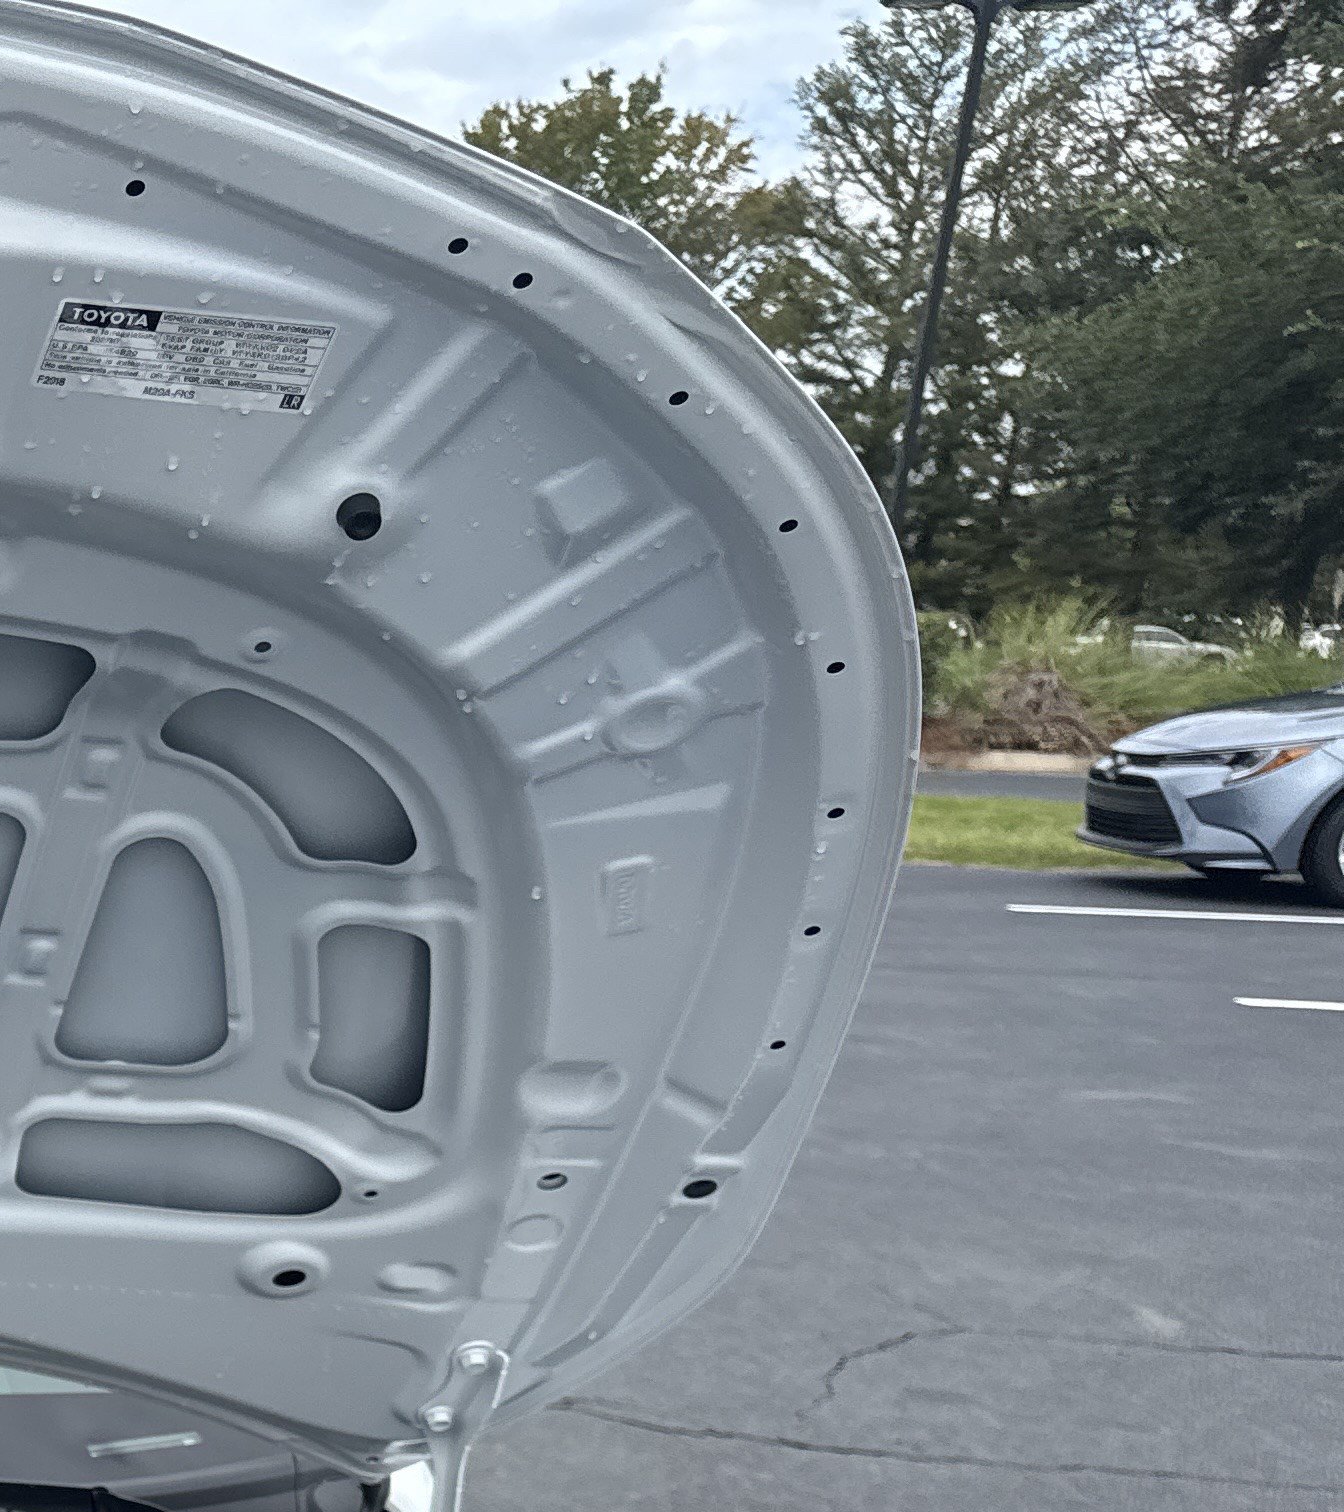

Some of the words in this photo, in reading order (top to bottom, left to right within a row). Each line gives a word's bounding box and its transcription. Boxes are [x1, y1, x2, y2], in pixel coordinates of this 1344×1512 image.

[72, 307, 148, 327] TOYOTA
[212, 329, 243, 339] MOTOR
[238, 320, 274, 331] CONTROL
[277, 324, 331, 337] INFORMATION
[282, 395, 302, 409] LR
